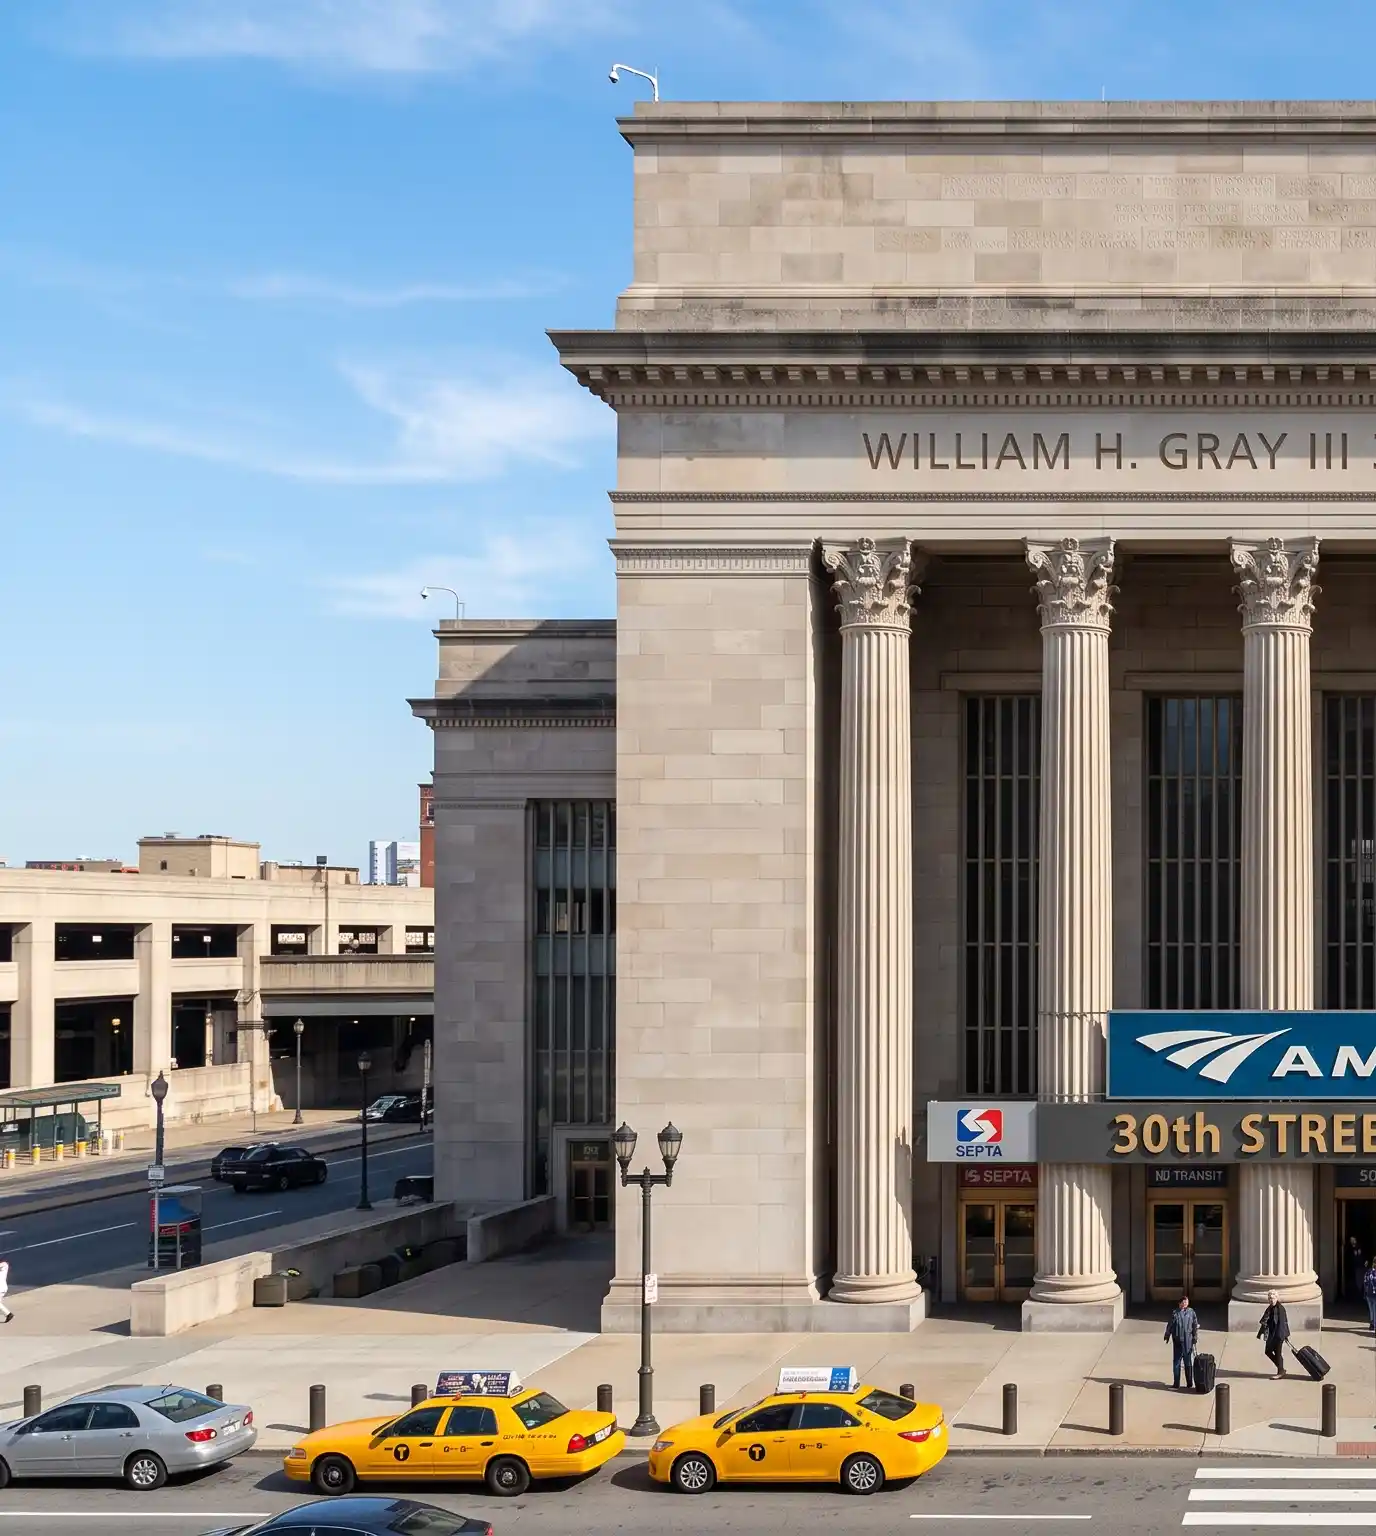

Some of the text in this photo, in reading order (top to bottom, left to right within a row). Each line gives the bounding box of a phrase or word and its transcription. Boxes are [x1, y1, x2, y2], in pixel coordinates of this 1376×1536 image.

[861, 432, 1071, 470] WILLIAM
[1094, 432, 1138, 470] H.
[1158, 432, 1288, 470] GRAY
[1308, 432, 1349, 470] III
[1112, 1111, 1221, 1154] 30th
[956, 1145, 1003, 1158] SEPTA
[983, 1169, 1032, 1183] SEPTA
[1174, 1170, 1223, 1182] TRANSIT
